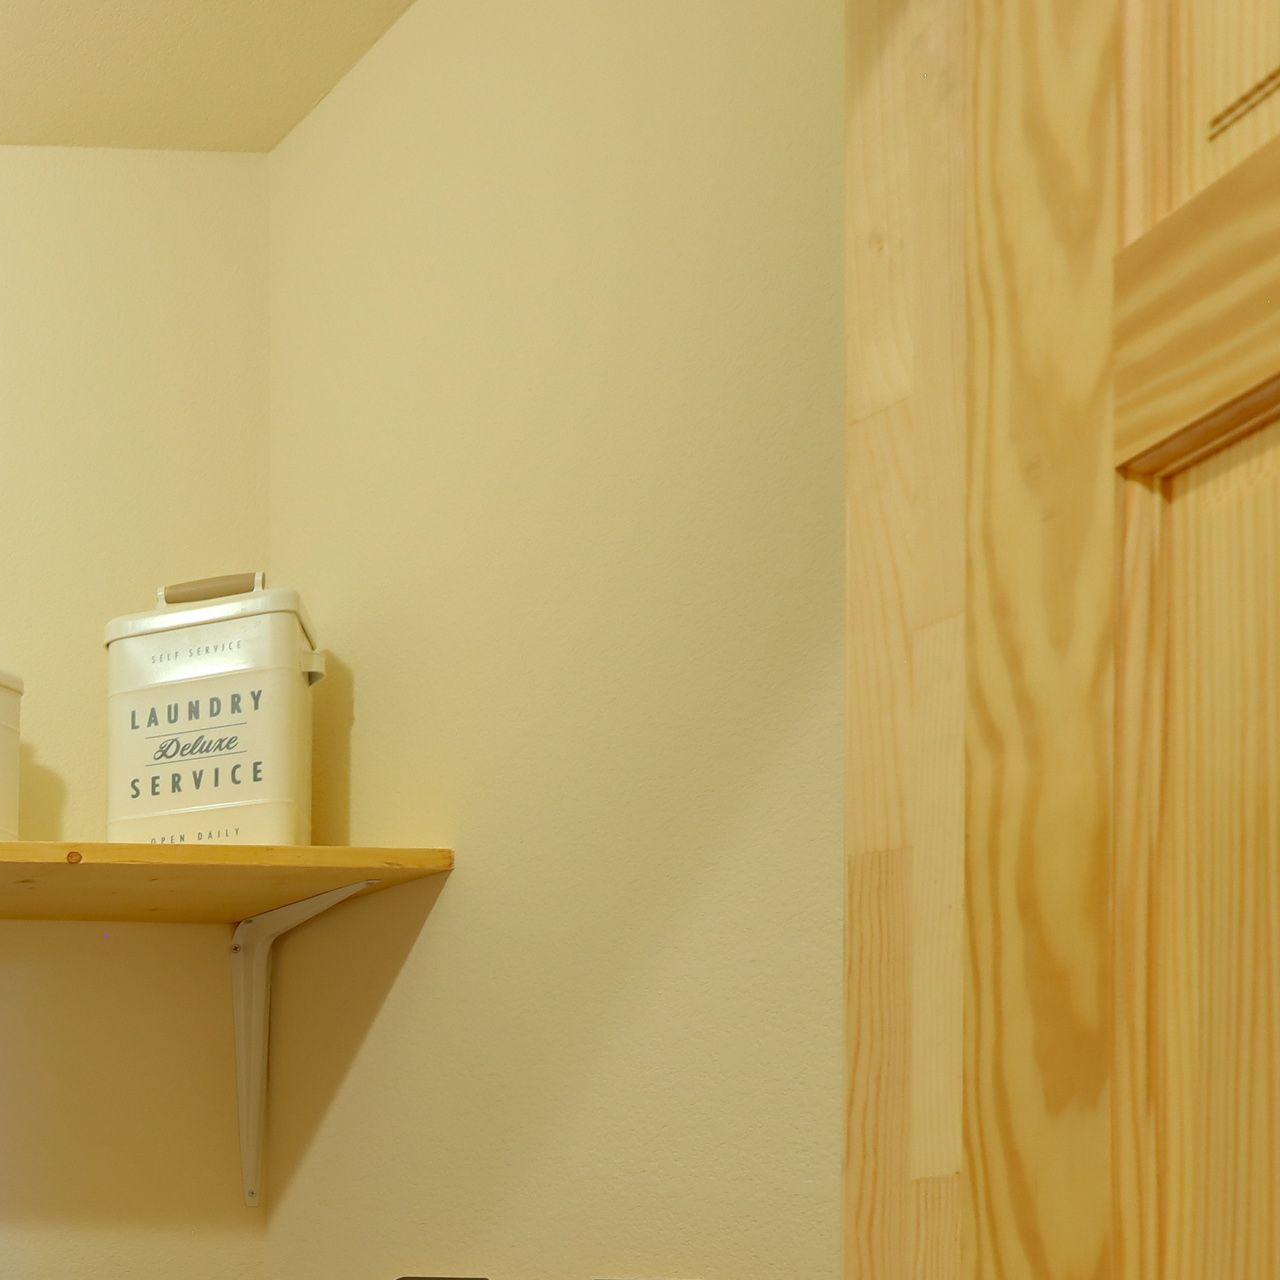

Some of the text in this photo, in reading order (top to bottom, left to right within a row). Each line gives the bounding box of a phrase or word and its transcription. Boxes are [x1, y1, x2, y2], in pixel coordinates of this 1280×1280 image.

[152, 640, 241, 664] SELF SERVICE
[131, 690, 262, 730] LAUNDRY
[153, 735, 238, 761] Deluxe
[131, 761, 263, 799] SERVICE
[151, 828, 240, 844] OPEN DAILY
